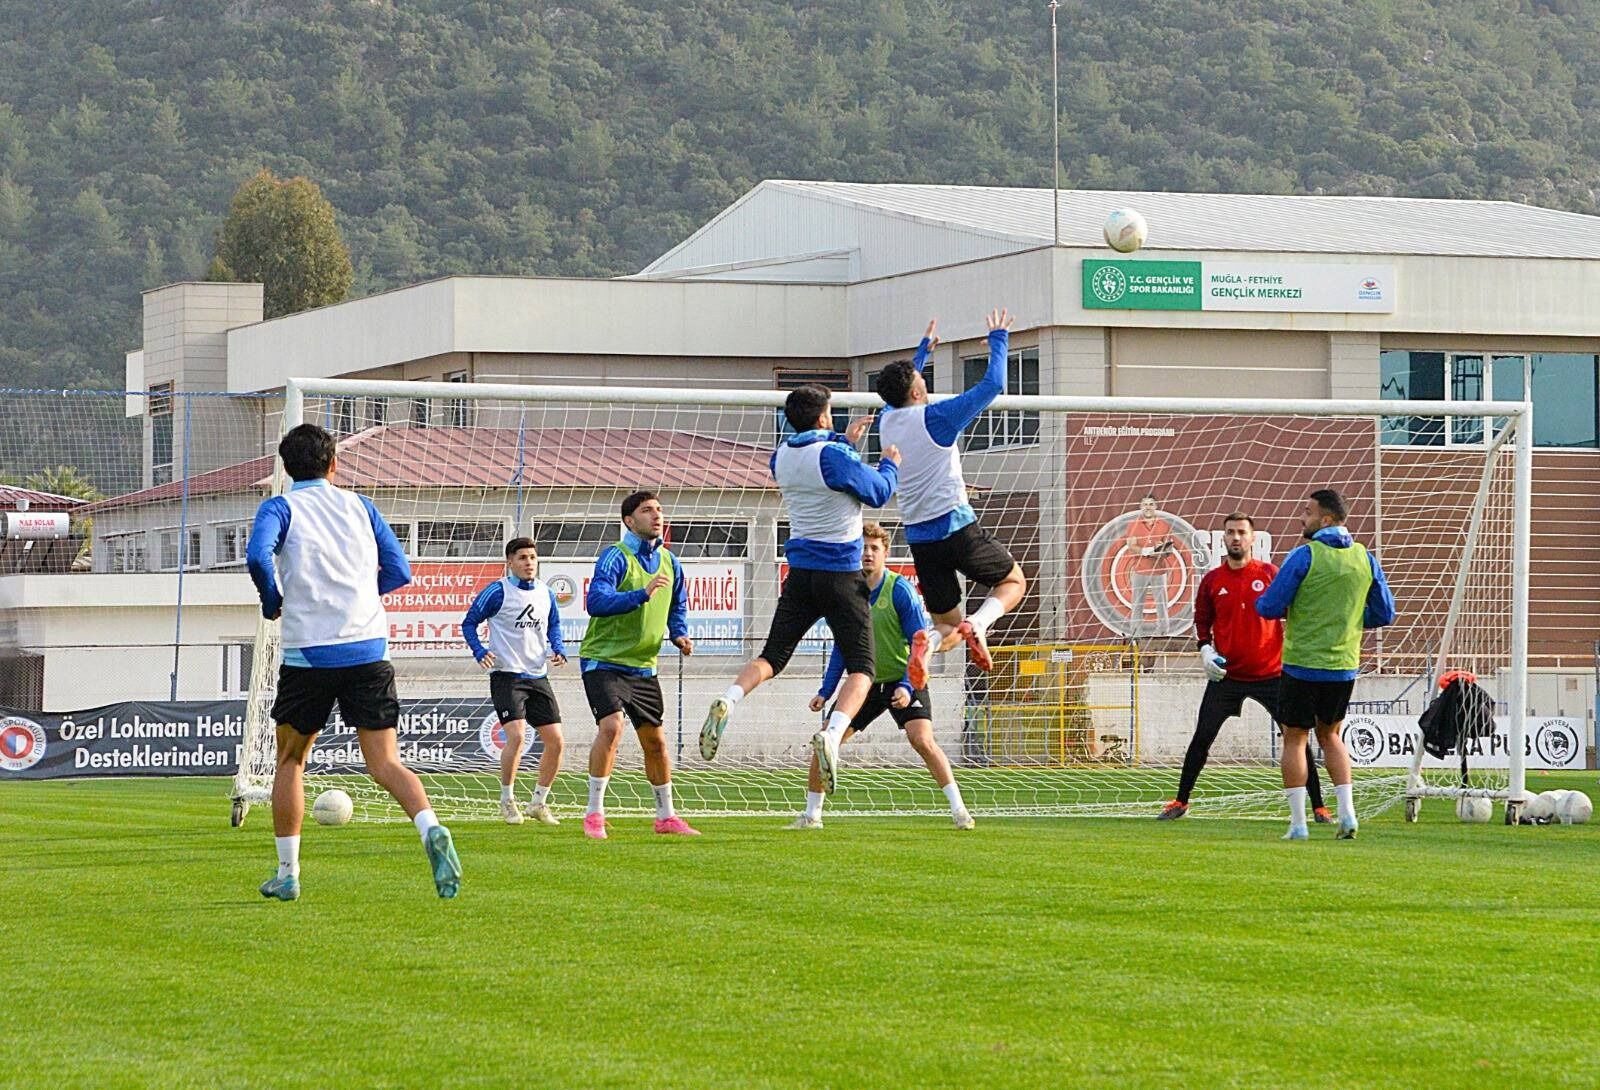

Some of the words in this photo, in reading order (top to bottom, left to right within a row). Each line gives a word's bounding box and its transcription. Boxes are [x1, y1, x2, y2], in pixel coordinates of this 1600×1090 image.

[1129, 275, 1144, 284] T.C.
[1145, 274, 1181, 286] GENÇLİK
[1182, 276, 1195, 285] VE
[1211, 273, 1243, 284] MUĞLA
[1248, 275, 1283, 285] FETHİYE
[1129, 285, 1151, 294] SPOR
[1151, 285, 1195, 295] BAKANLIĞI
[1211, 286, 1256, 300] GENÇLİK
[1257, 287, 1303, 299] MERKEZİ
[1191, 529, 1272, 570] SPR
[455, 575, 474, 587] VE
[60, 715, 104, 741] Özel
[110, 715, 190, 738] Lokman
[196, 714, 246, 737] Heki
[74, 743, 228, 769] Desteklerinden
